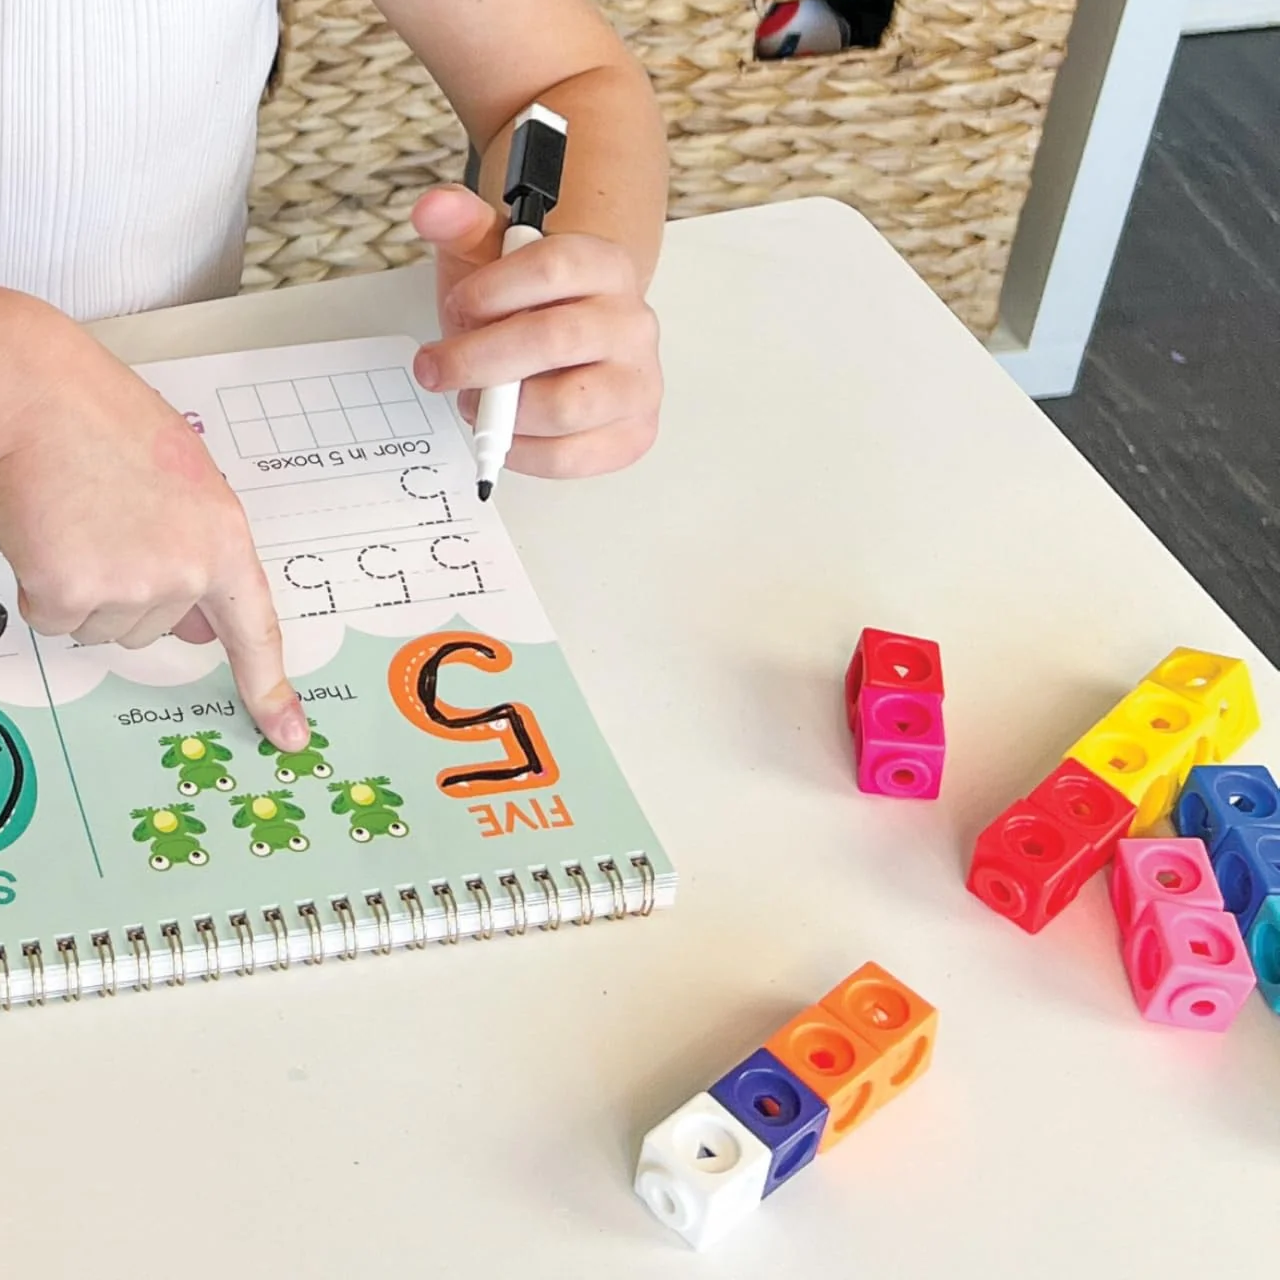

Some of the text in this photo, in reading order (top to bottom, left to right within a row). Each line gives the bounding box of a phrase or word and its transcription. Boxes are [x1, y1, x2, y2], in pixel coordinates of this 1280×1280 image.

[254, 439, 431, 471] Color in 5 boxes.
[400, 466, 452, 526] 5
[284, 535, 484, 617] 5 5 5
[115, 706, 184, 726] frogs.
[191, 703, 235, 718] five
[388, 631, 560, 799] 5
[468, 795, 575, 838] FIVE
